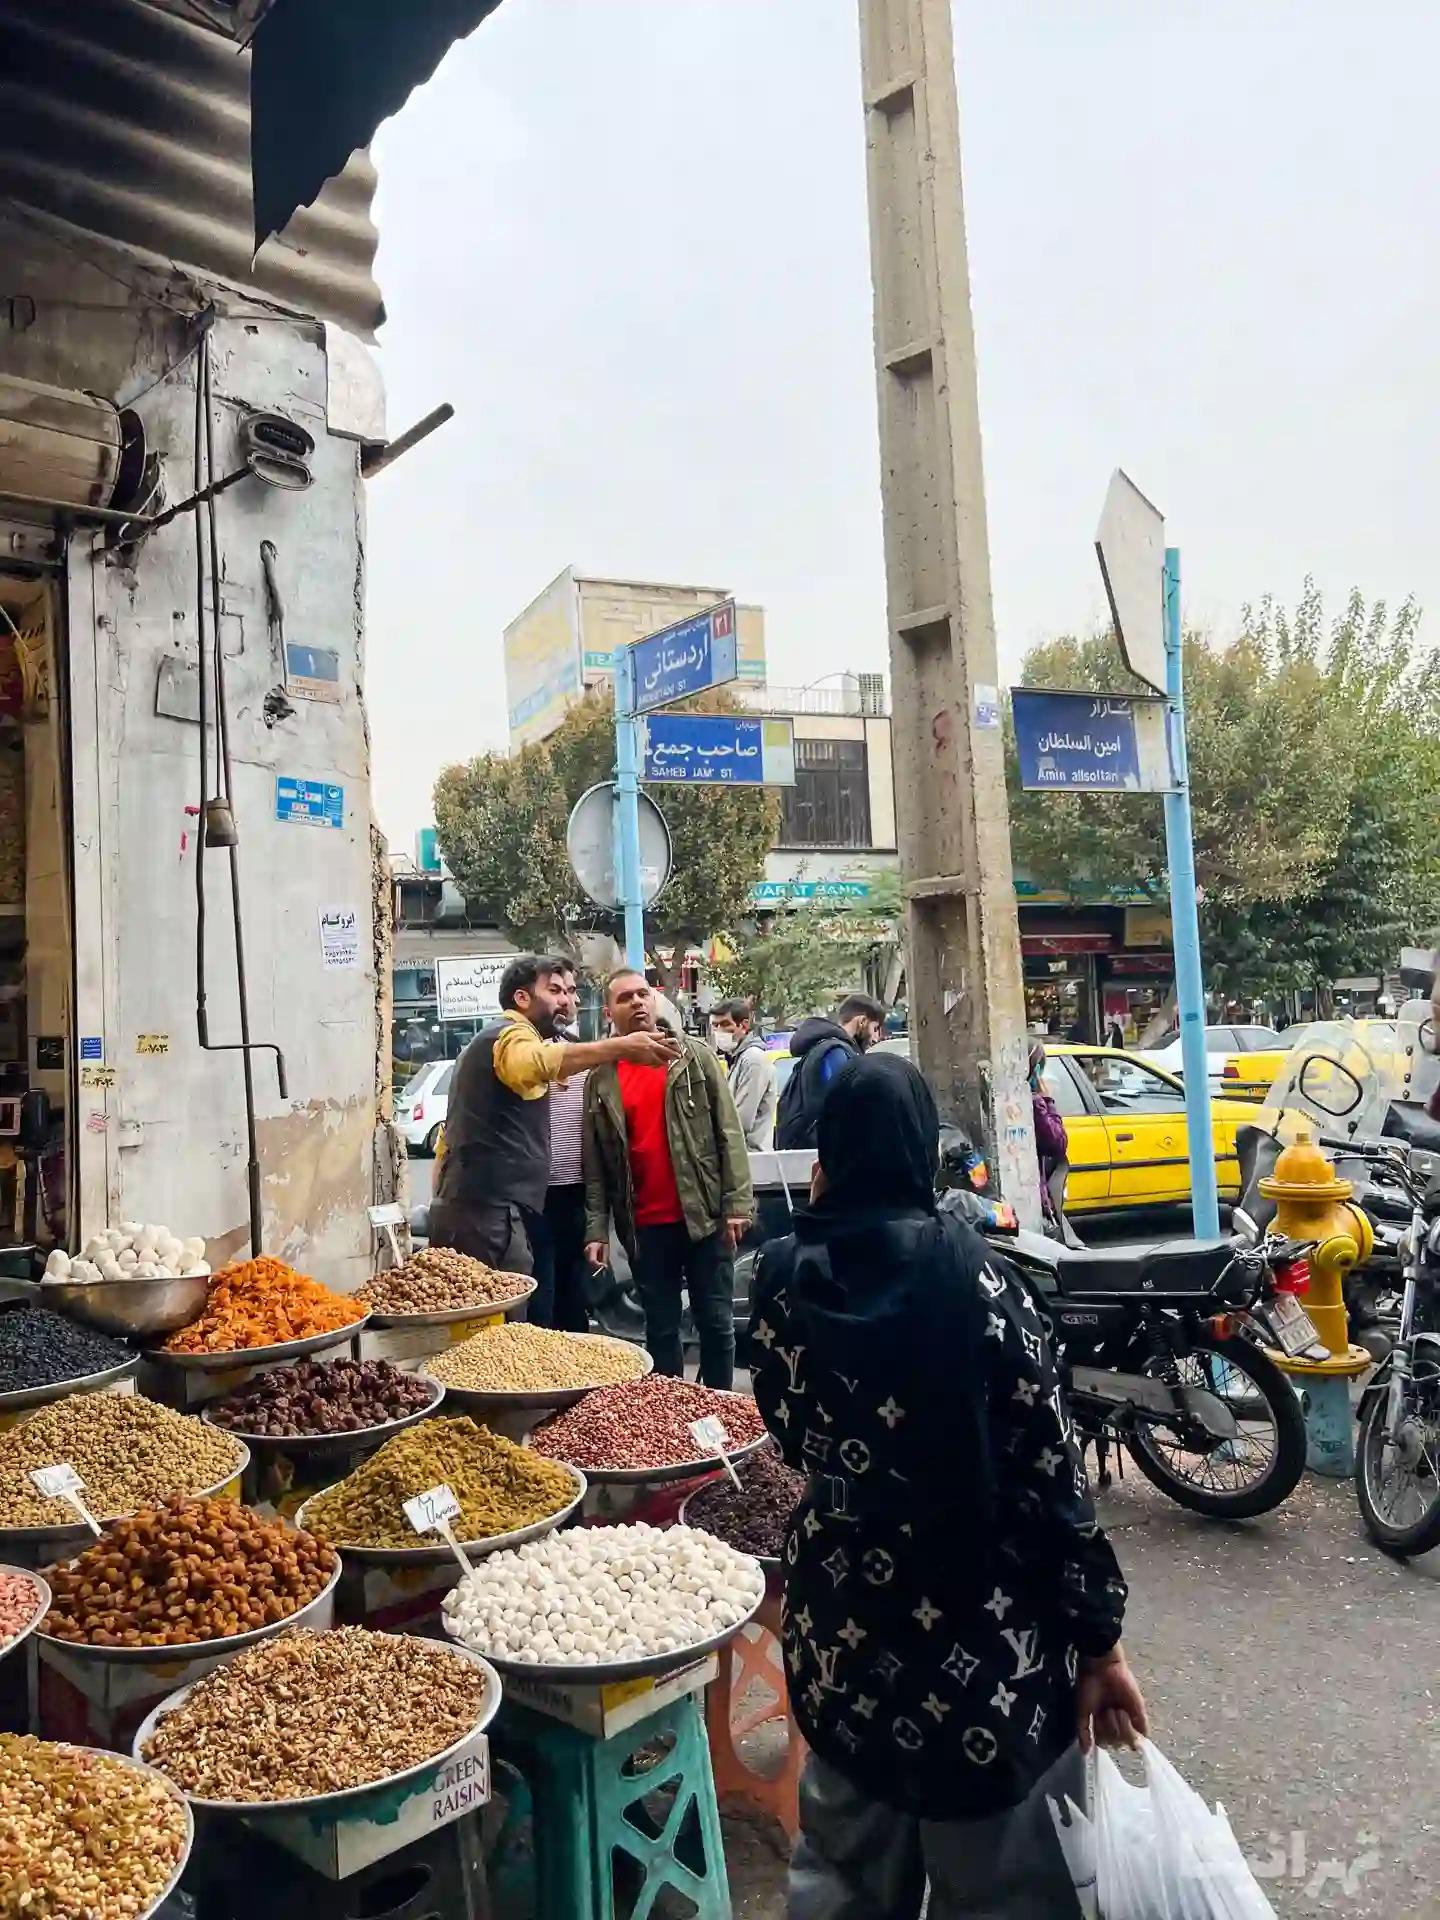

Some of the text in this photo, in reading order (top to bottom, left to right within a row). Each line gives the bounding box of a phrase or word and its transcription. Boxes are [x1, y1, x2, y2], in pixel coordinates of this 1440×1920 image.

[653, 737, 758, 766] صاحب جمع
[1038, 732, 1121, 757] امین السلطان
[651, 766, 687, 777] SAHEB
[1037, 767, 1067, 781] Amin
[432, 1751, 487, 1821] GREEN RAISIN
